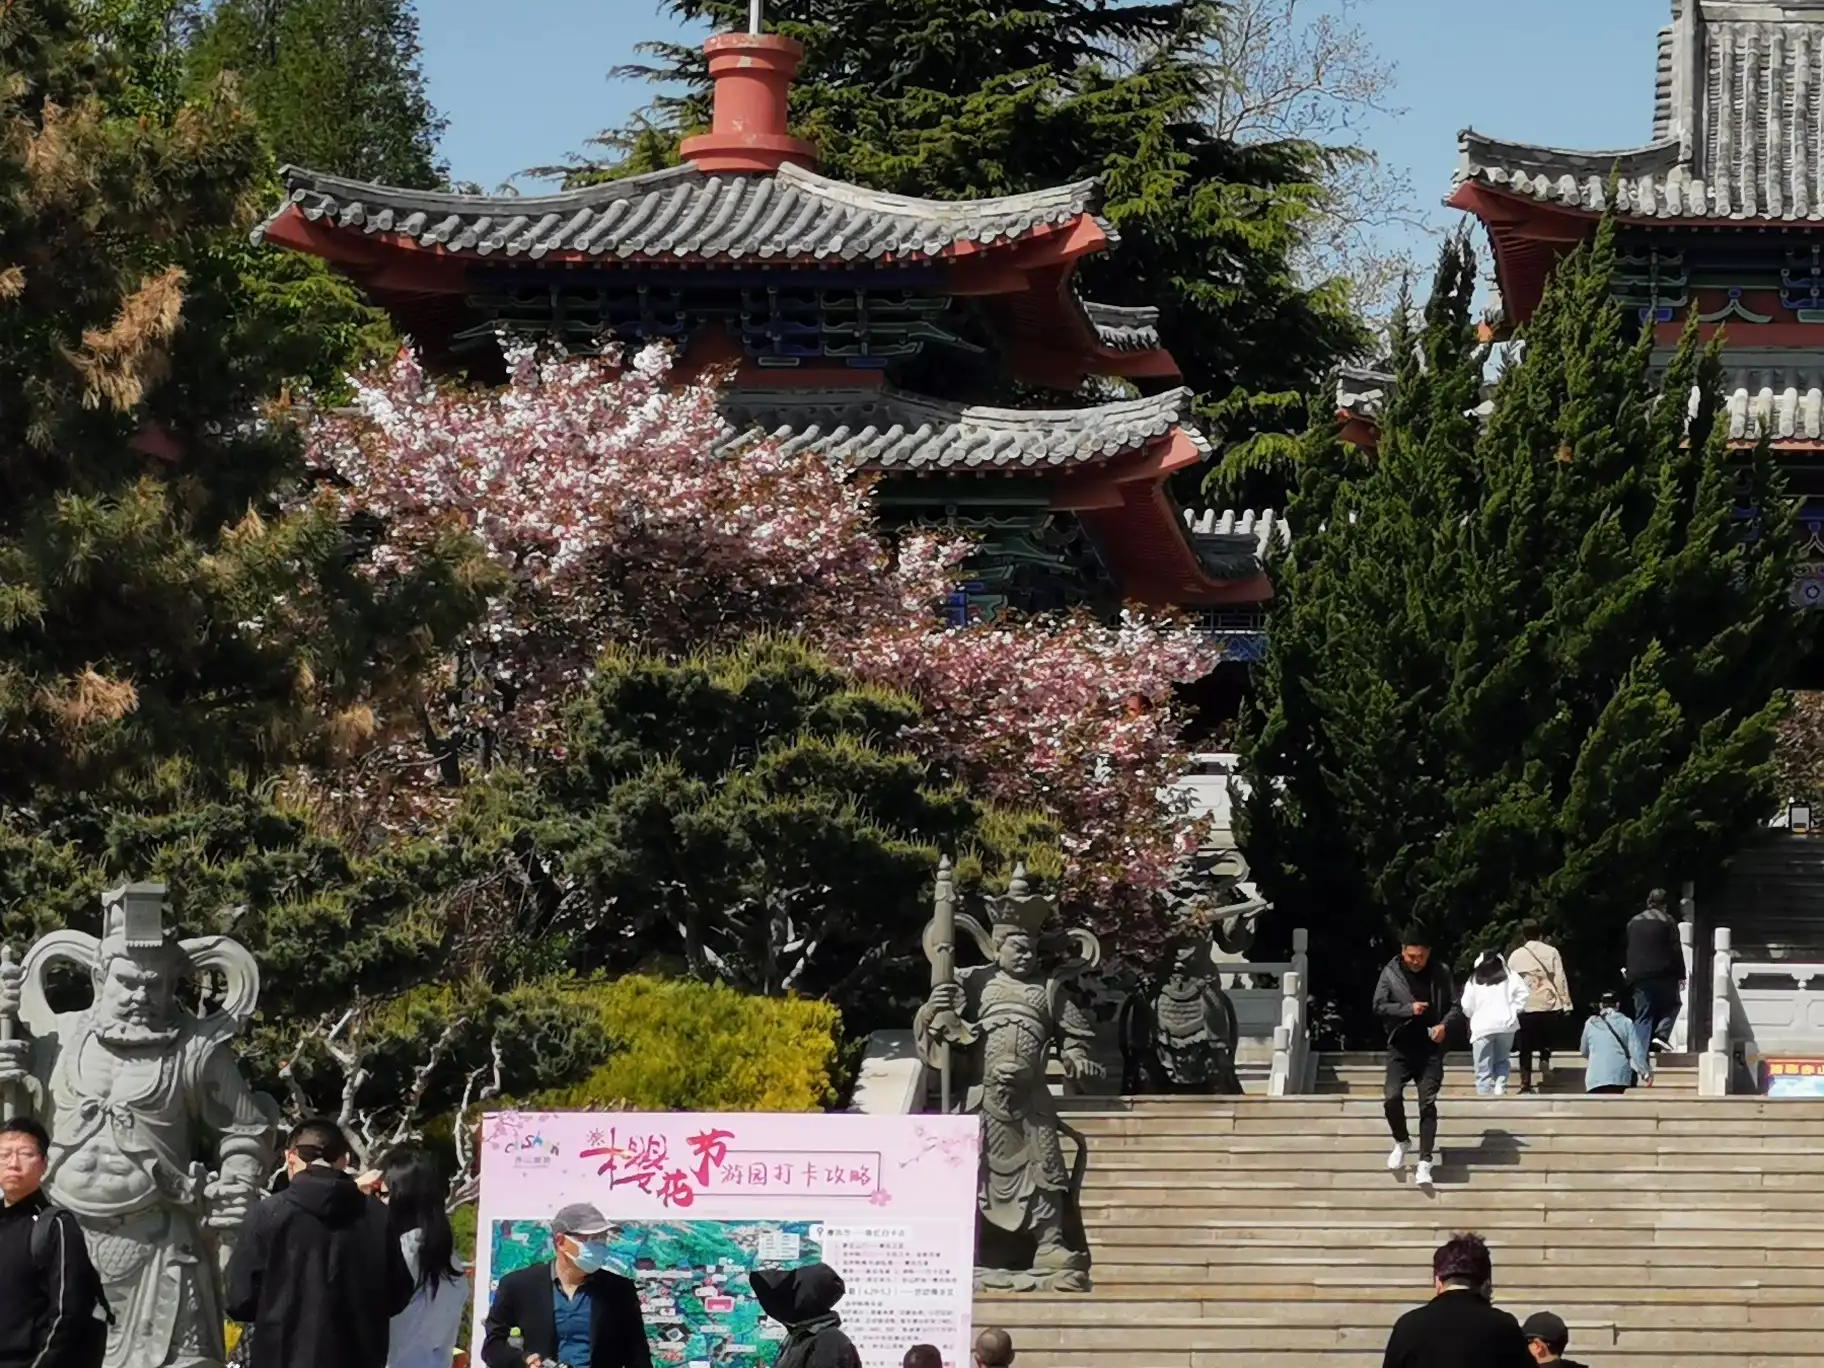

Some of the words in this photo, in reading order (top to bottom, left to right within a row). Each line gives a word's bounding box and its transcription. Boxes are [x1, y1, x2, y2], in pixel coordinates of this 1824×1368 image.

[579, 1127, 734, 1208] 樱花节
[721, 1161, 872, 1188] 游园打卡攻略
